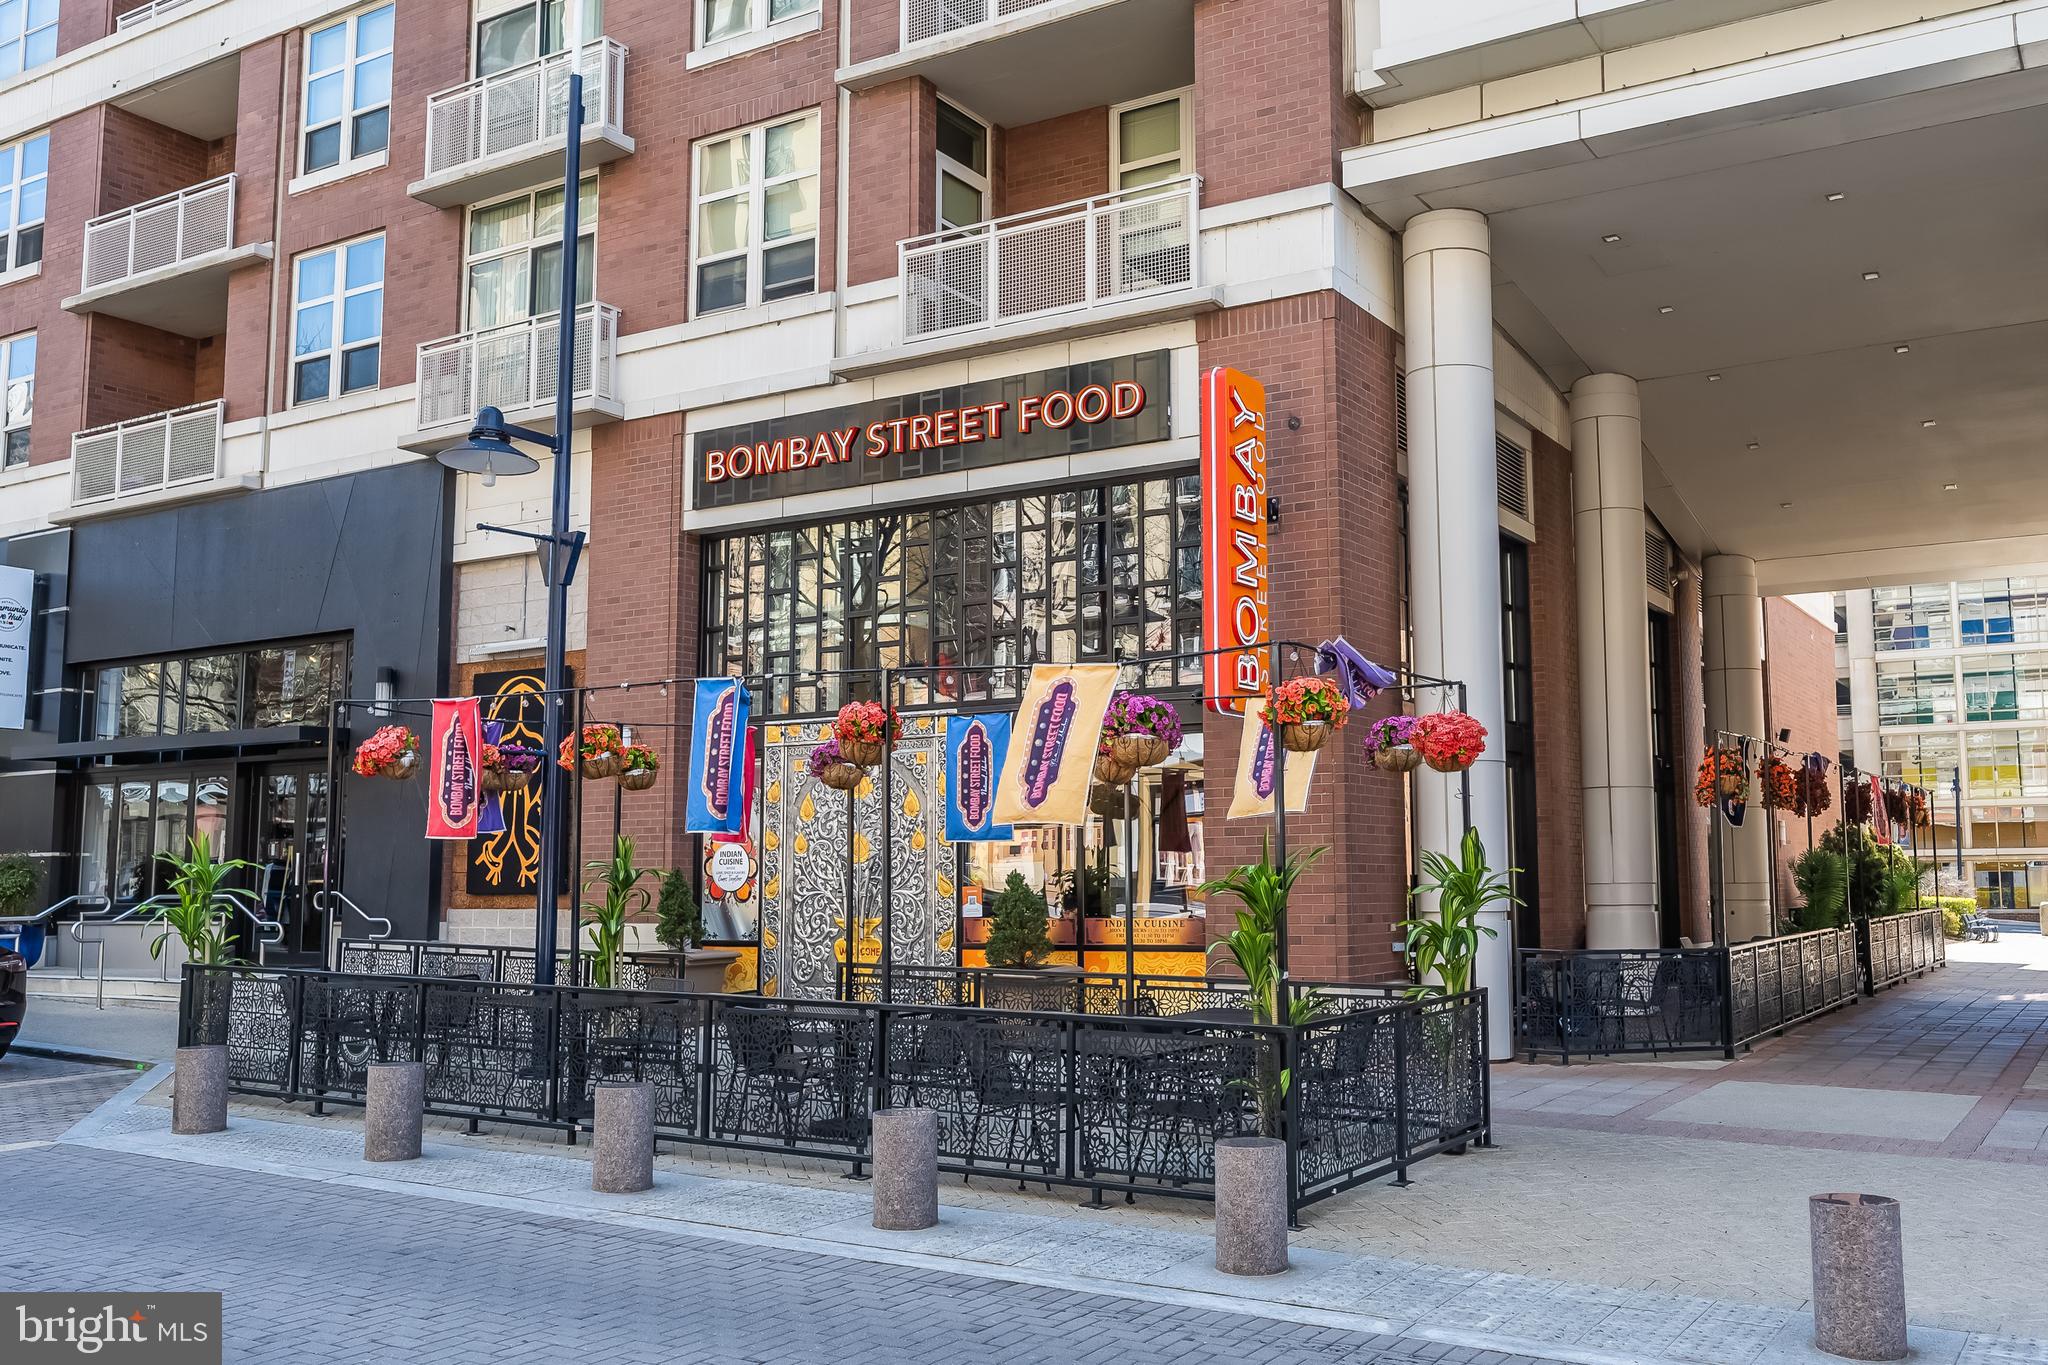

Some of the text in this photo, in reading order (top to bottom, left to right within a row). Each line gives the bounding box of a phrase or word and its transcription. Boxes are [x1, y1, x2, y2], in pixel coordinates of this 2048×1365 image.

[705, 380, 1146, 483] BOMBAY STREET FOOD
[1254, 412, 1266, 520] FOOD
[1230, 385, 1260, 692] BOMBAY
[1030, 692, 1068, 799] BOMBAY STREET FOOD
[451, 749, 465, 780] STREET
[969, 734, 981, 820] BOMBAY STREET FOOD
[450, 781, 464, 816] BOMBAY
[715, 767, 729, 806] BOMBAY
[718, 858, 744, 866] CUISINE
[719, 850, 743, 858] INDIAN
[1105, 919, 1186, 928] INDIN CUISINE
[839, 947, 880, 956] WCOME
